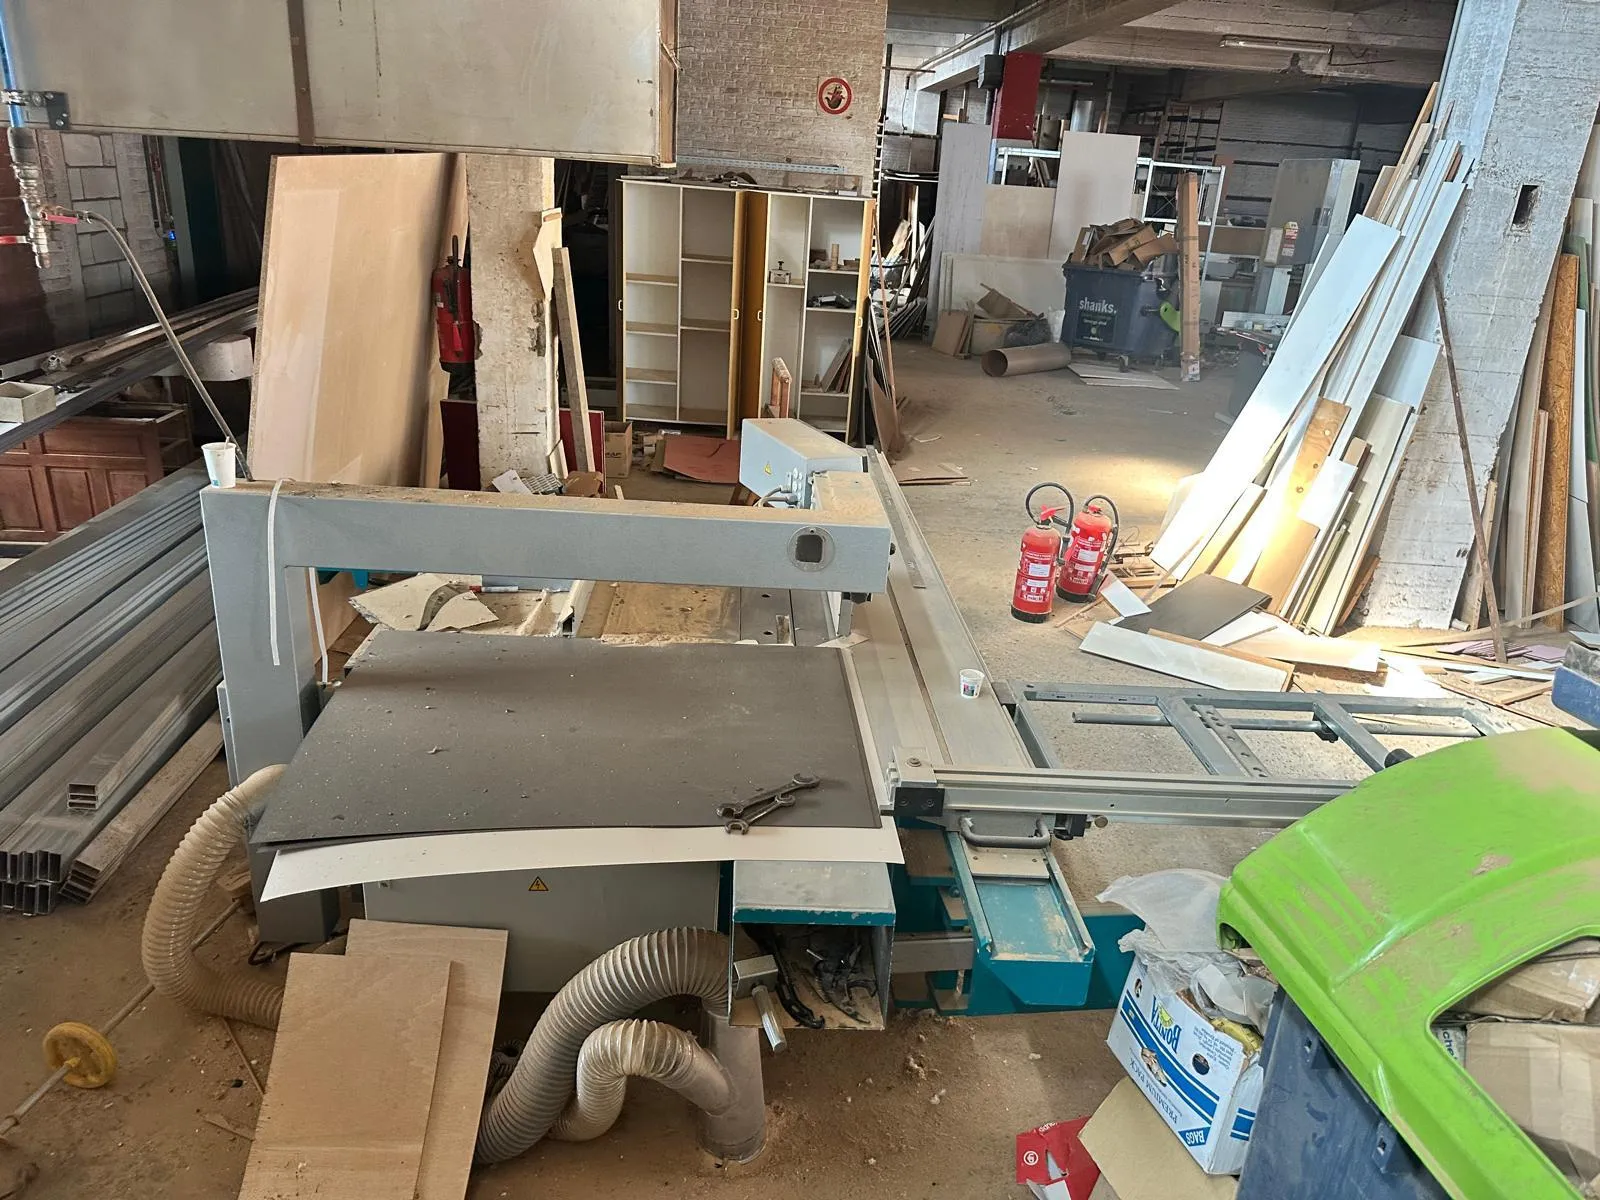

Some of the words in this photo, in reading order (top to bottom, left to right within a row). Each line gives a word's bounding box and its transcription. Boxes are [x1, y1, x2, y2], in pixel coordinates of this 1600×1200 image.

[1079, 296, 1117, 314] shanks.
[1151, 995, 1182, 1054] BONITA
[1130, 1058, 1145, 1082] PACK
[1146, 1081, 1178, 1123] PREMIUM
[1185, 1130, 1205, 1144] BAGS
